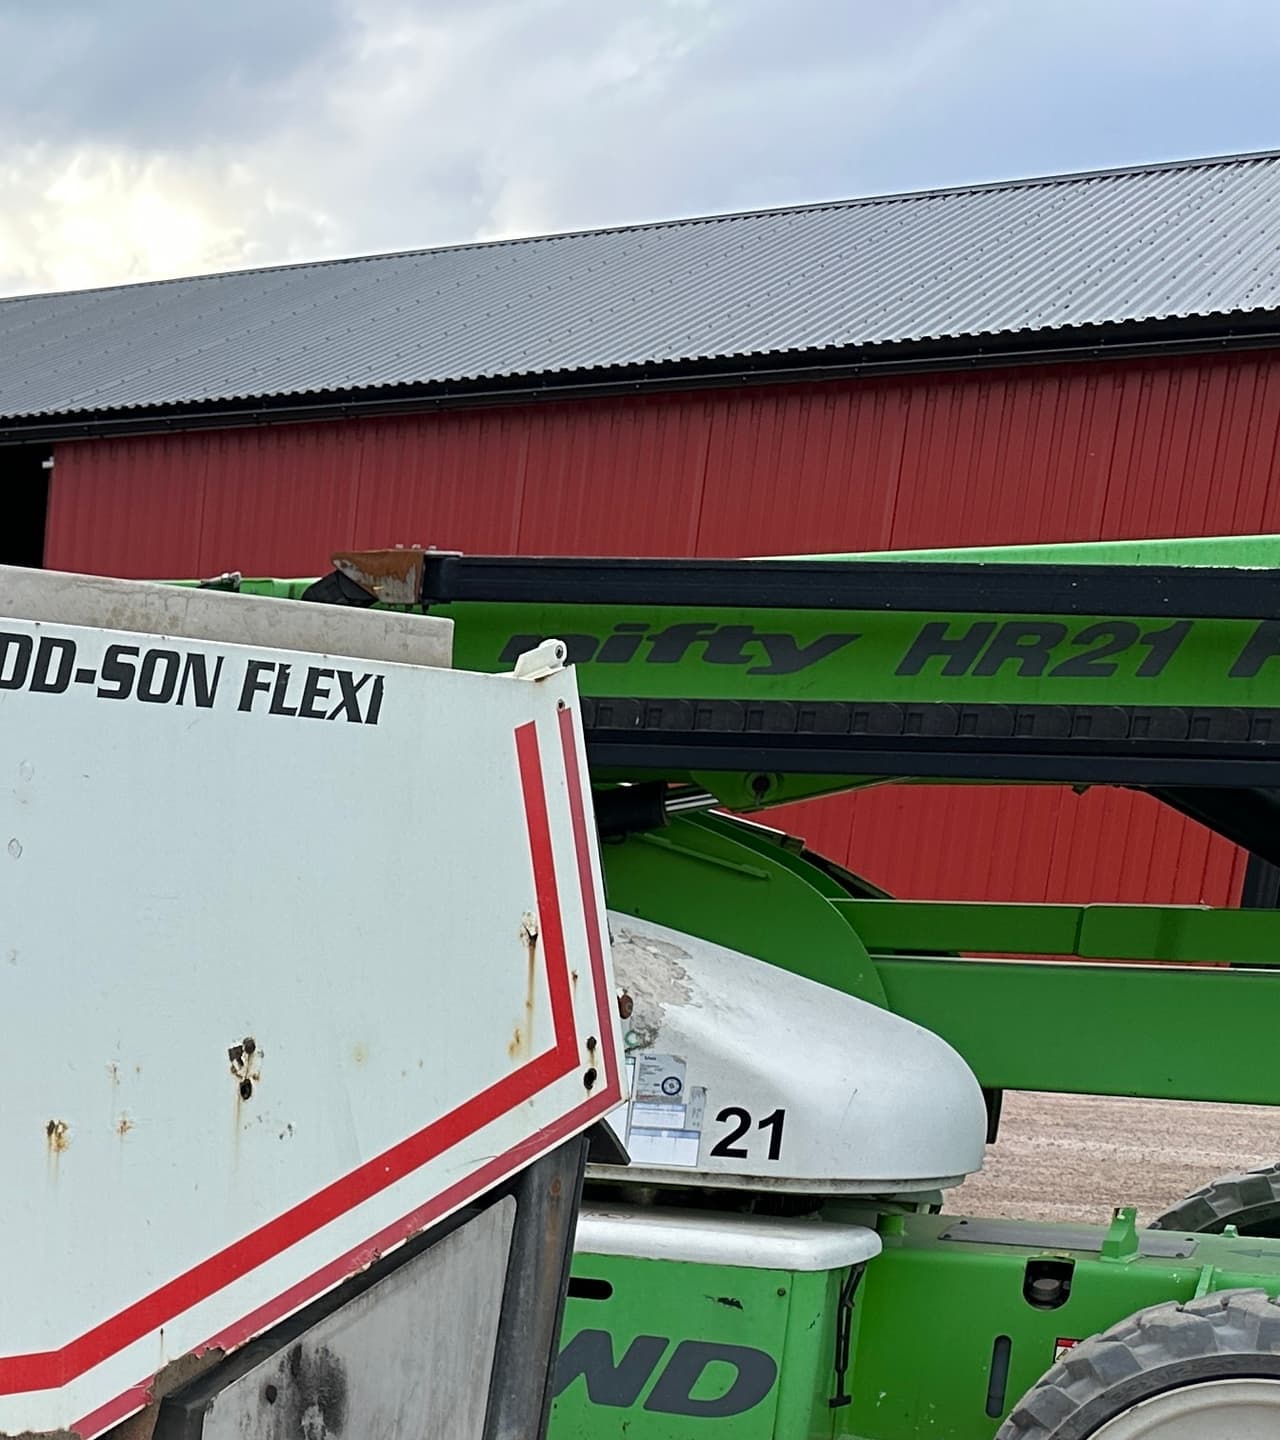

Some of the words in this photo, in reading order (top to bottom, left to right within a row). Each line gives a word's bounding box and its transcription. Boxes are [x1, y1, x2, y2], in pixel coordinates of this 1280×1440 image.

[894, 619, 1195, 678] HR21
[237, 659, 386, 727] FLEXI
[709, 1106, 787, 1161] 21
